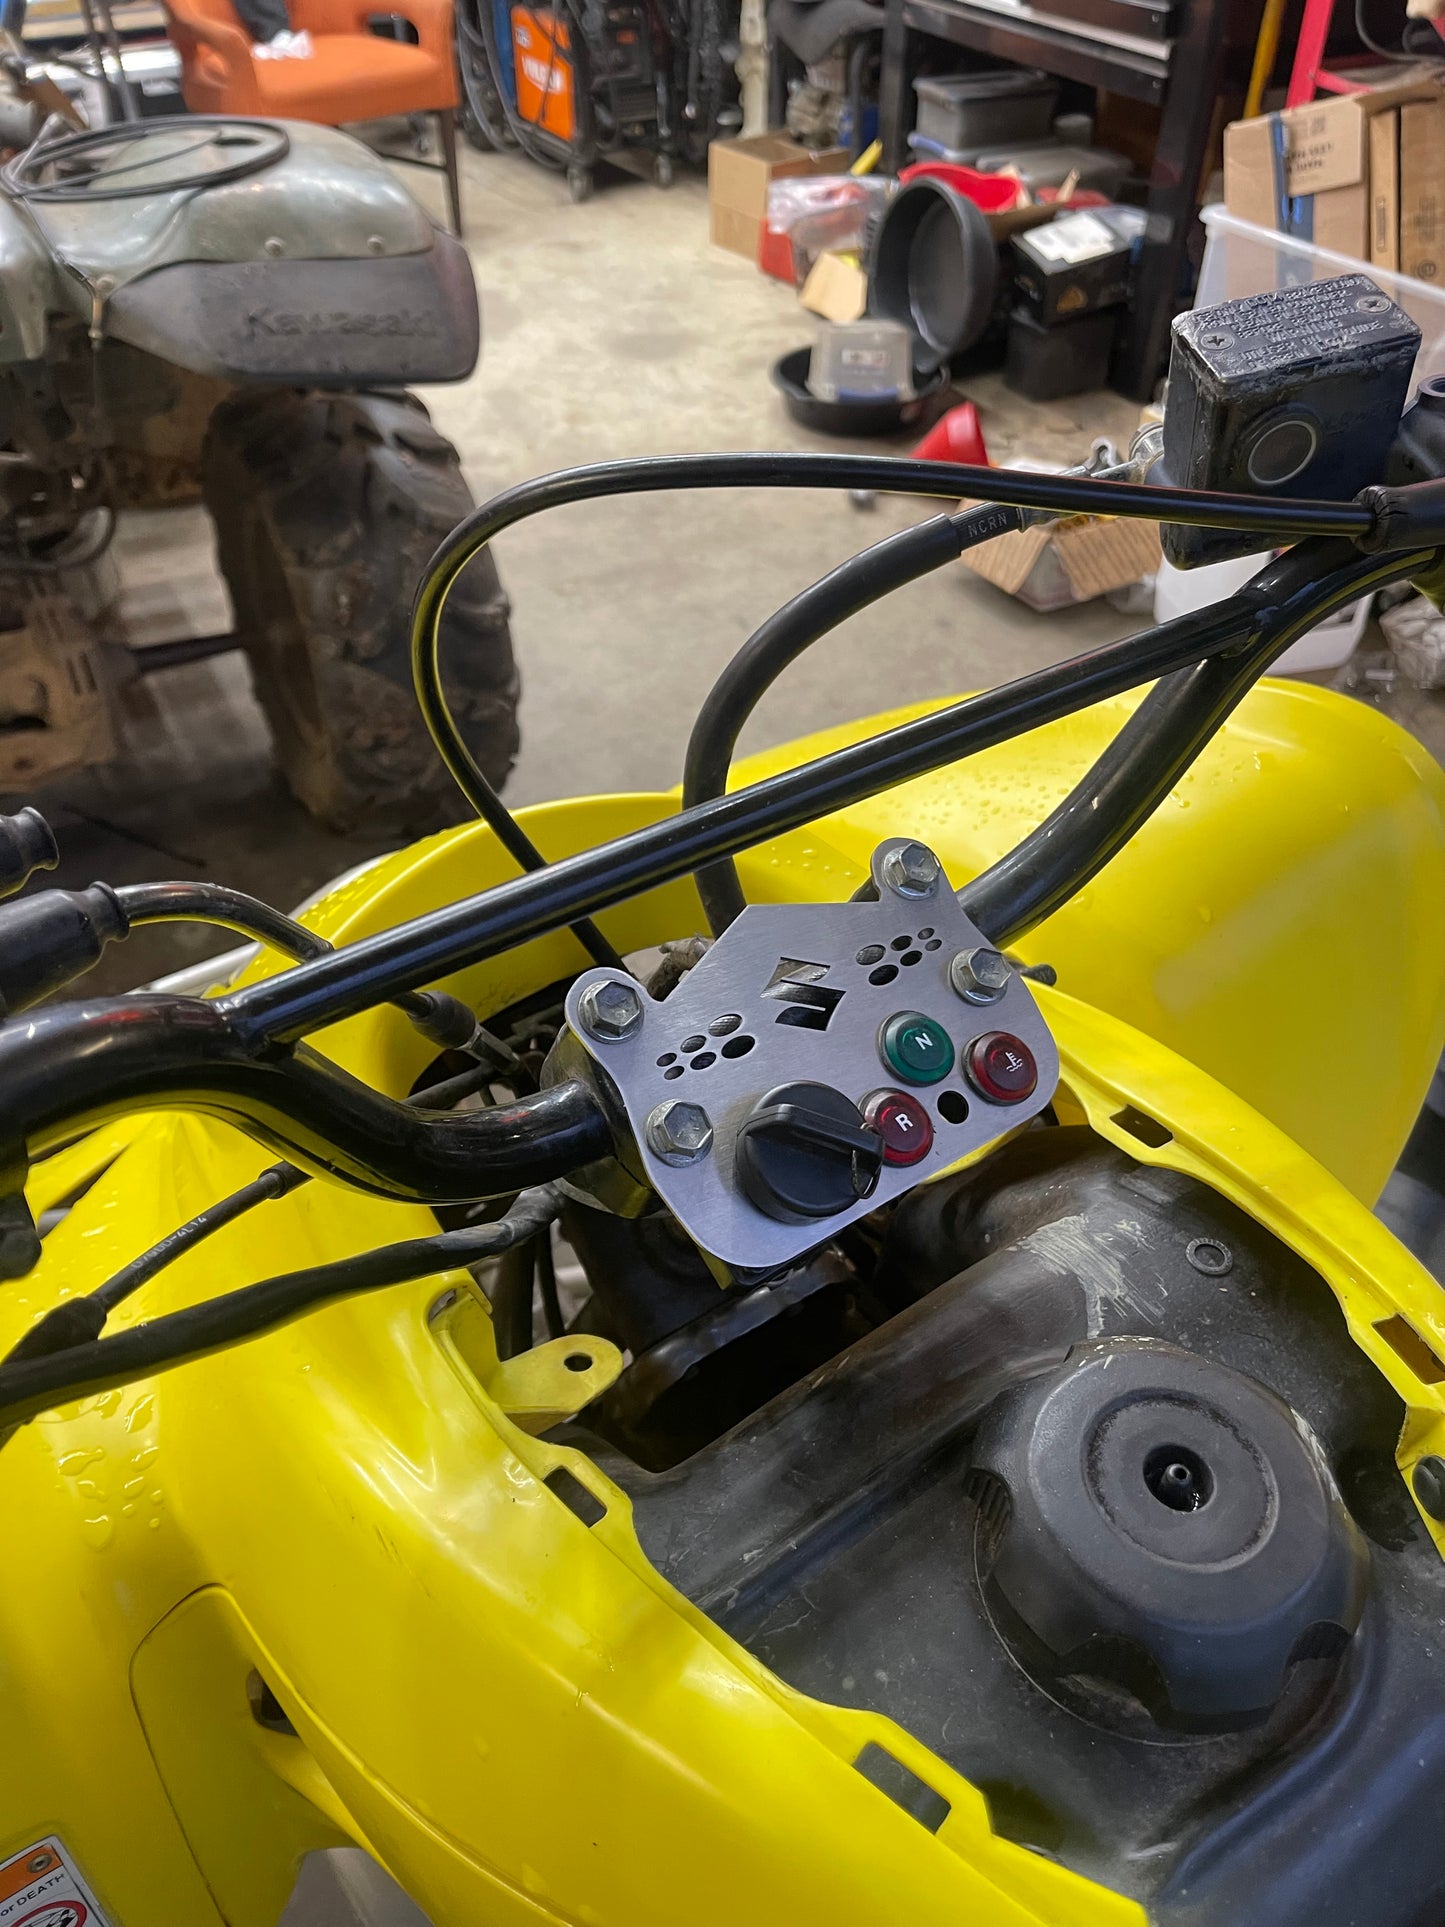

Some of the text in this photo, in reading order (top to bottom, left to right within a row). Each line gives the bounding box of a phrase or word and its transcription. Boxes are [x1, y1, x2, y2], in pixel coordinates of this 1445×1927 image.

[1284, 283, 1326, 300] BRAKE
[1265, 317, 1344, 344] WARNING
[967, 512, 1008, 538] NCRN
[915, 1032, 933, 1050] N
[895, 1113, 914, 1132] R
[0, 1873, 65, 1917] or DEATH
